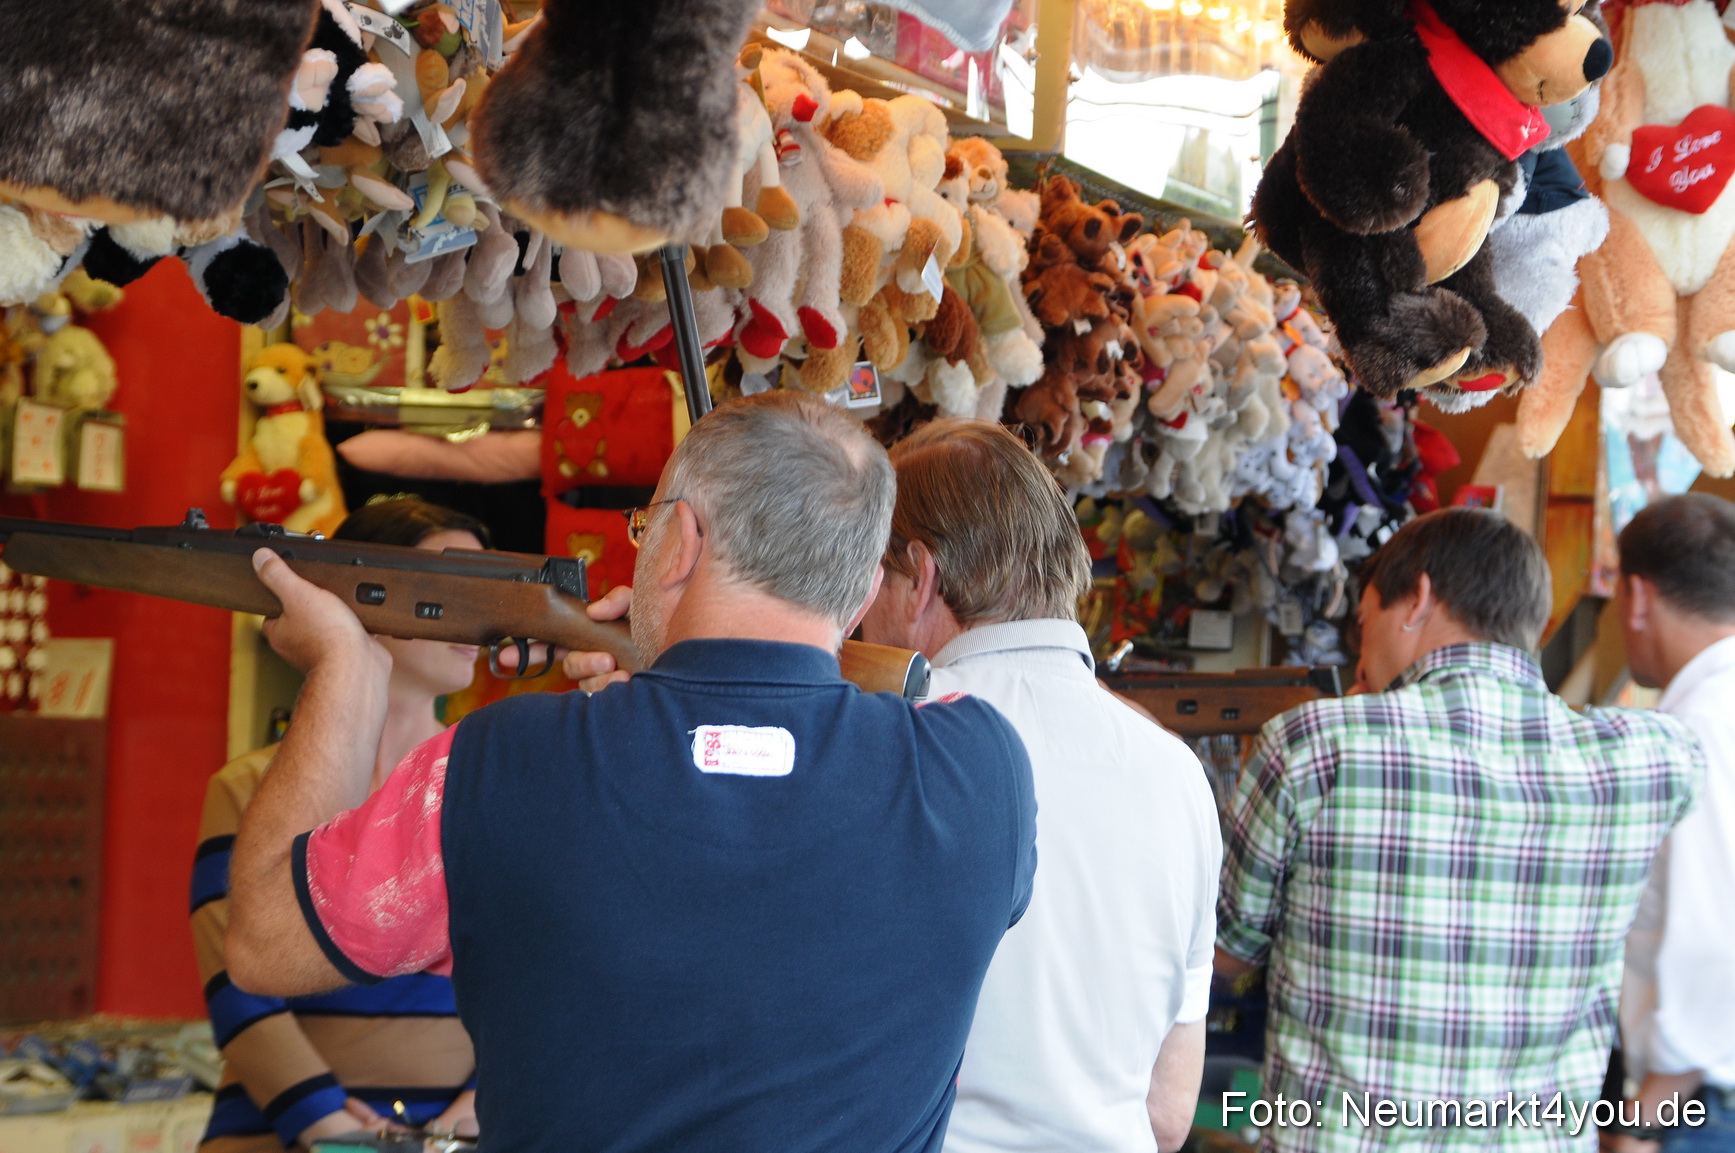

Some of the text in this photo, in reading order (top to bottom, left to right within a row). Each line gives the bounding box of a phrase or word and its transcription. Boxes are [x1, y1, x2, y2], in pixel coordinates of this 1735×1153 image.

[1645, 130, 1721, 173] I Love
[1669, 163, 1716, 194] You
